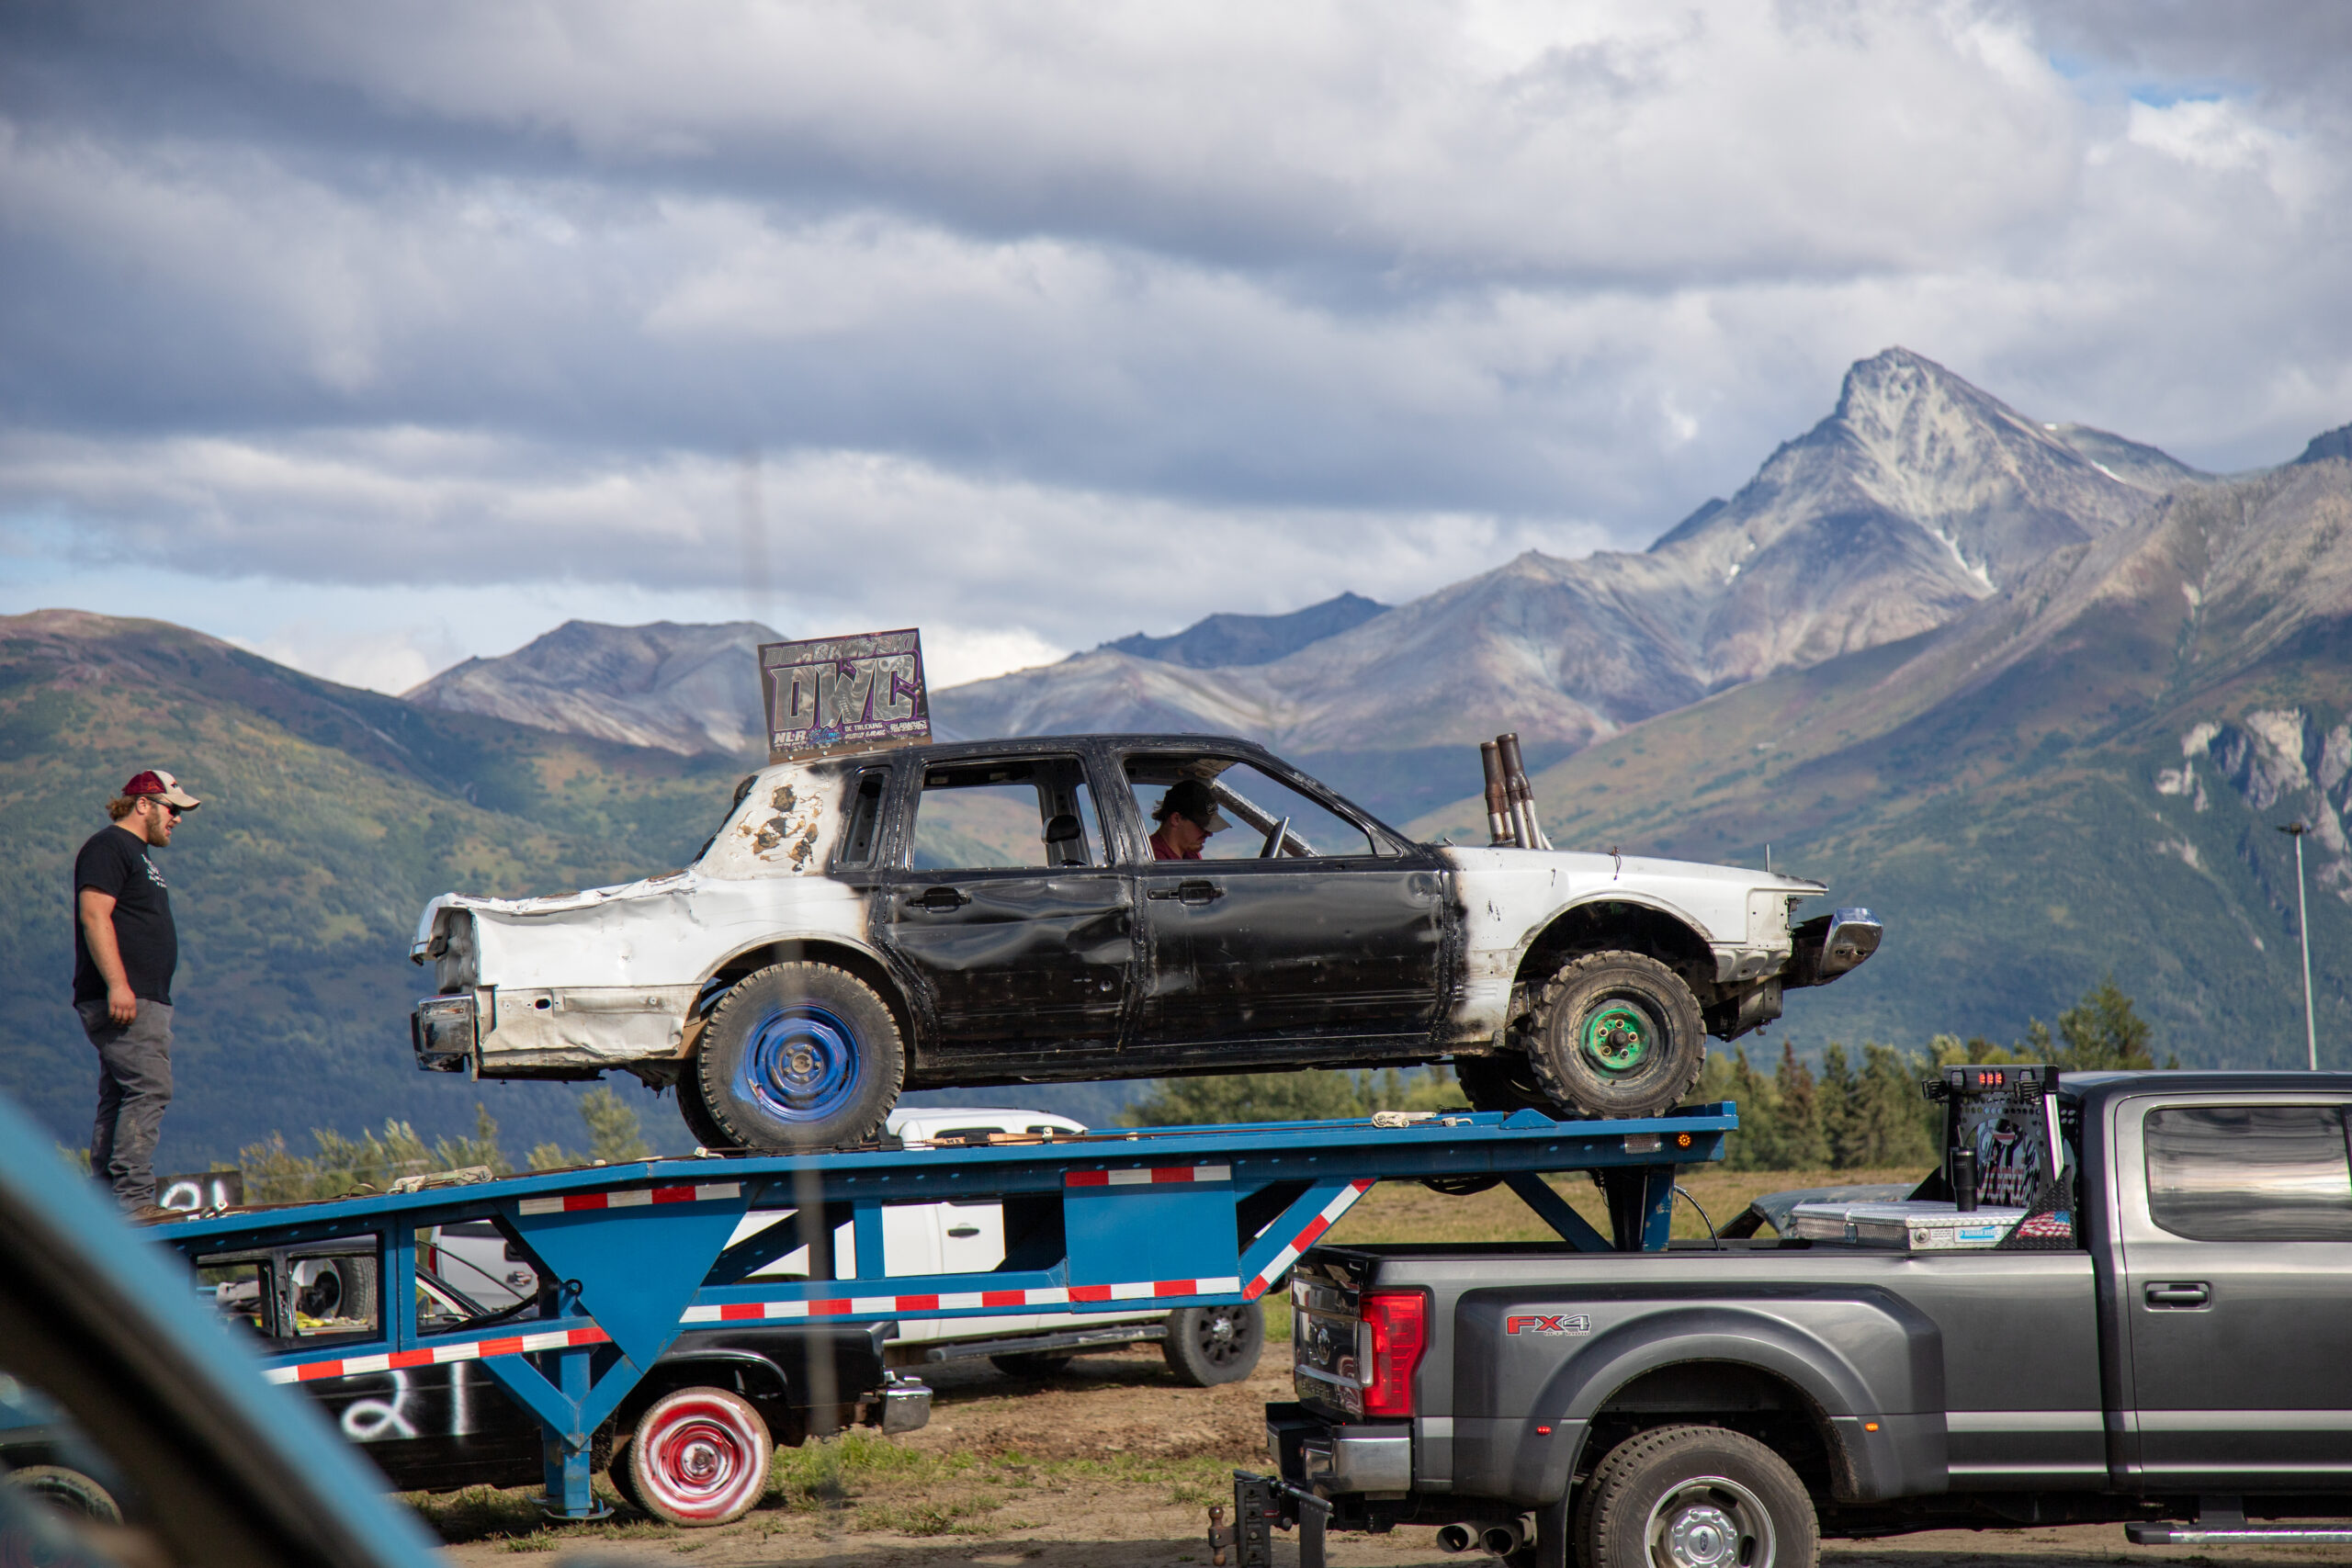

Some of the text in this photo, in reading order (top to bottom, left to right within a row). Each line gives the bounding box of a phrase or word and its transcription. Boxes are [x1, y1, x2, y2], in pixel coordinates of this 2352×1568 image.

[764, 633, 916, 666] DOMBROWSKI
[771, 654, 915, 732] DWC
[854, 722, 883, 731] TRUCKING
[1506, 1314, 1590, 1336] FX4
[341, 1359, 469, 1439] 21
